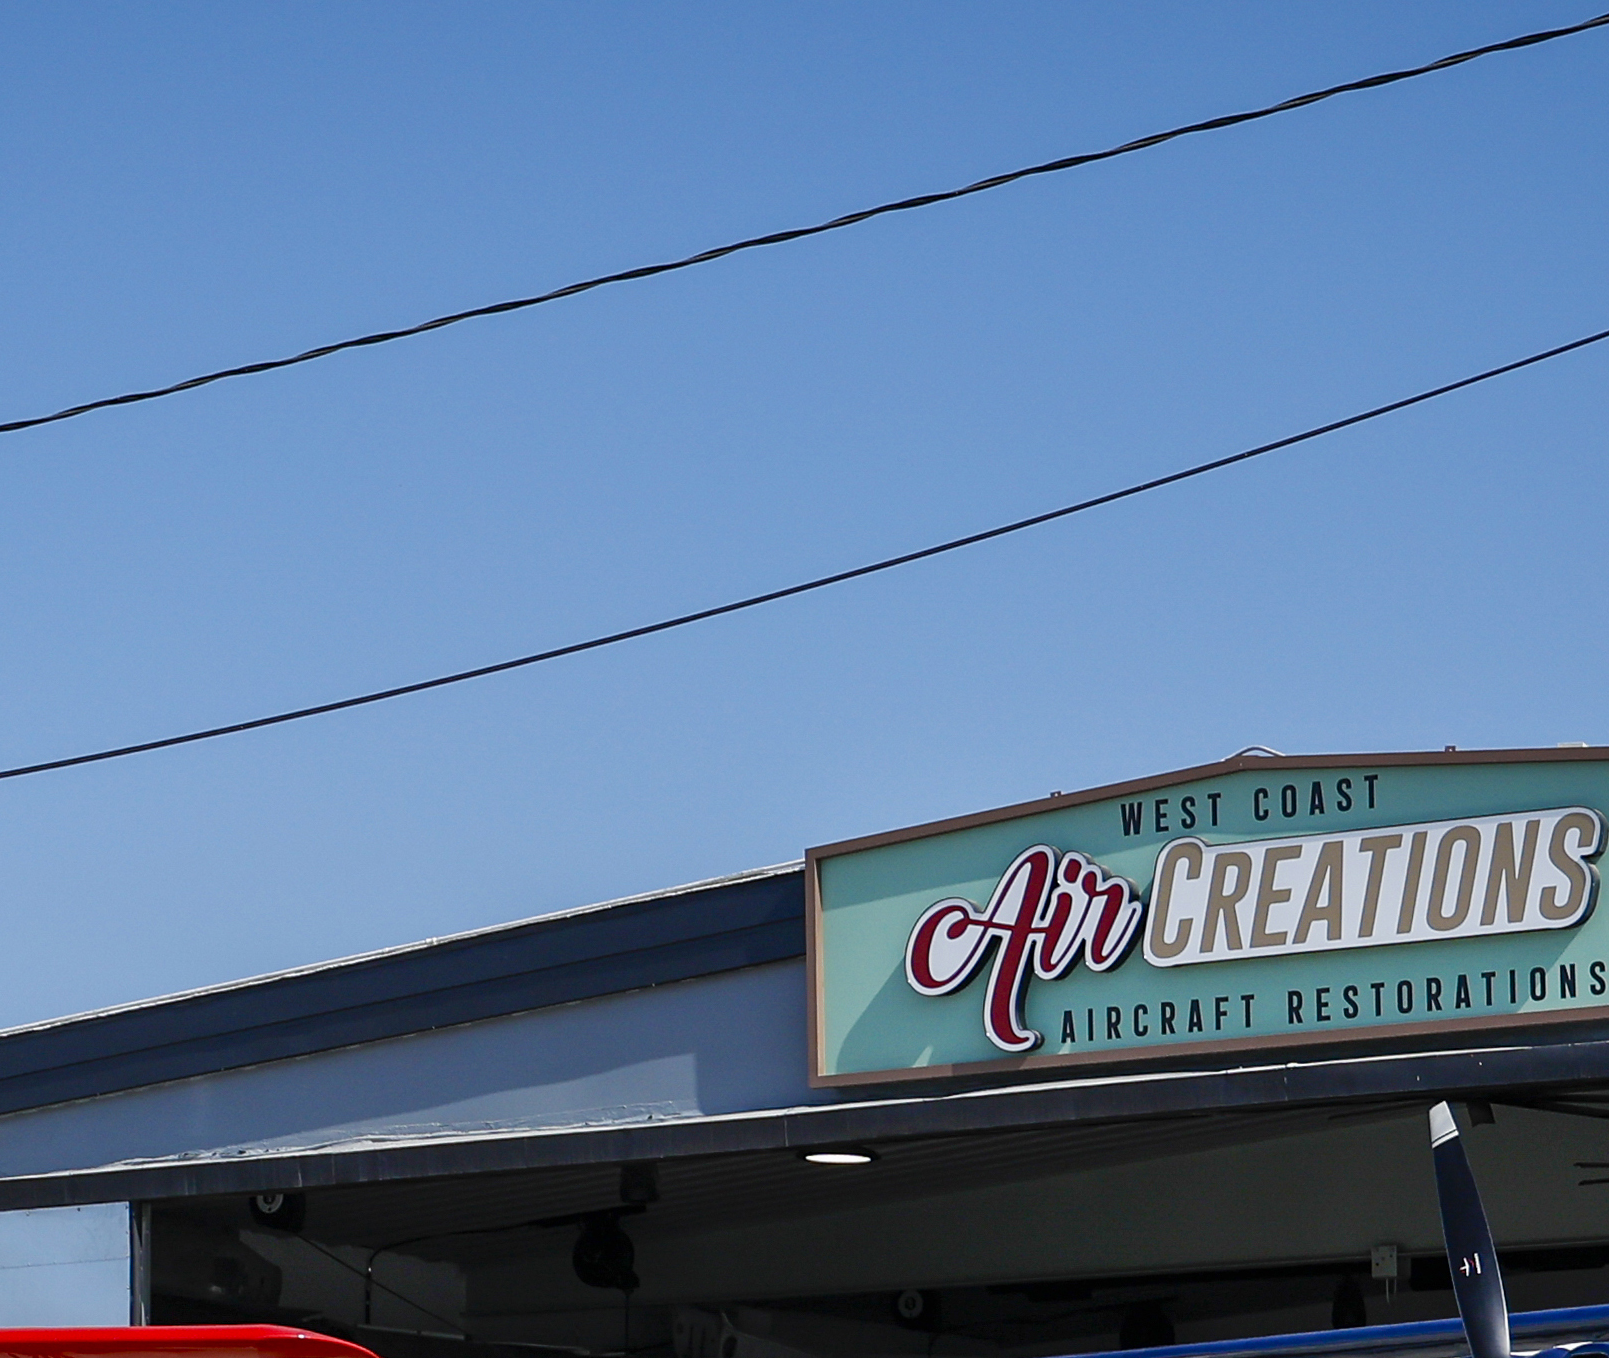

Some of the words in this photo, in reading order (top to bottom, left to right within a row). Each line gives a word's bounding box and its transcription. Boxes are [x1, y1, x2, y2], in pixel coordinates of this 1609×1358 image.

[1120, 792, 1222, 836] WEST
[1253, 774, 1379, 822] COAST
[909, 848, 1140, 1047] Air
[1148, 811, 1596, 959] CREATIONS
[1060, 993, 1255, 1044] AIRCRAFT
[1287, 960, 1607, 1025] RESTORATIONS
